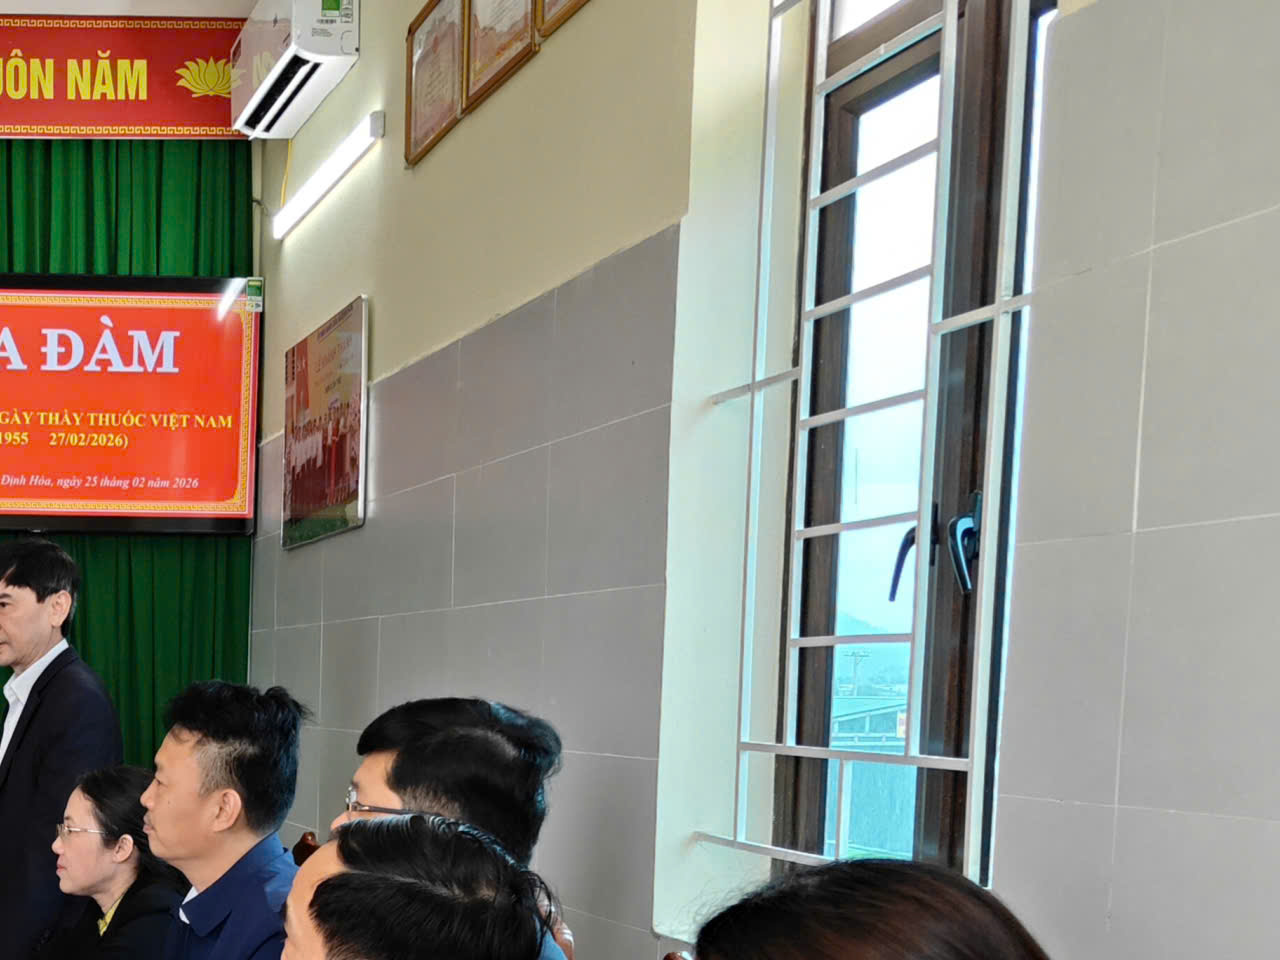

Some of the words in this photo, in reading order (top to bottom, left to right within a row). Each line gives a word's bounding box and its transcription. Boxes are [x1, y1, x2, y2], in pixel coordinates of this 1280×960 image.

[67, 50, 148, 101] NĂM
[40, 315, 180, 373] ĐÀM
[150, 411, 190, 431] VIỆT
[194, 414, 233, 429] NAM
[49, 432, 129, 449] 27/02/2026)
[0, 474, 26, 487] Định
[56, 476, 82, 489] ngày
[85, 476, 98, 487] 25
[100, 476, 130, 490] tháng
[132, 477, 145, 488] 02
[172, 477, 200, 489] 2026
